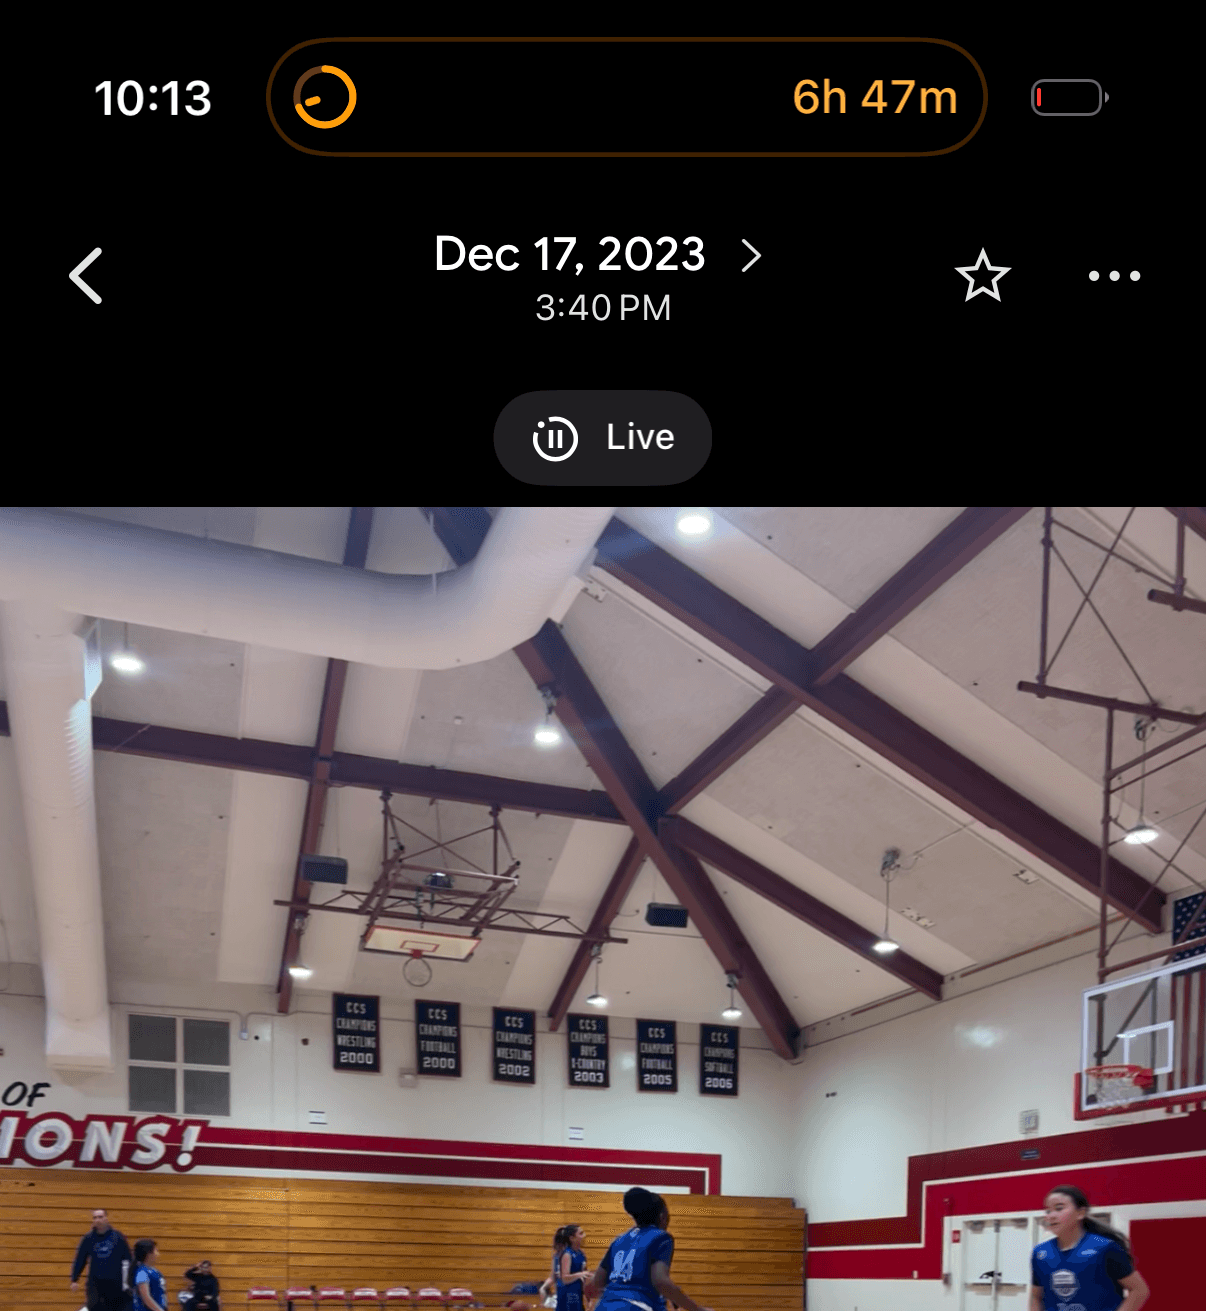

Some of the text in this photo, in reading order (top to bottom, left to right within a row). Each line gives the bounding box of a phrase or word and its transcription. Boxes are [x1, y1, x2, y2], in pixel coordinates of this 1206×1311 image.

[346, 1002, 366, 1014] CCS
[428, 1008, 448, 1020] CCS
[336, 1018, 376, 1031] CHAMPIONS
[505, 1016, 524, 1028] CCS
[579, 1019, 597, 1031] CCS
[419, 1024, 457, 1037] CHAMPIONS
[648, 1027, 666, 1038] CCS
[337, 1035, 376, 1048] WRESTLING
[496, 1031, 533, 1045] CHAMPIONS
[570, 1032, 606, 1044] CHAMPIONS
[710, 1032, 729, 1043] CCS
[420, 1040, 456, 1054] FOOTBALL
[640, 1042, 674, 1054] CHAMPIONS
[704, 1047, 735, 1058] CHAMPIONS
[340, 1052, 373, 1064] 2000
[497, 1047, 532, 1061] WRESTLING
[423, 1056, 455, 1069] 2000
[641, 1058, 673, 1070] FOOTBALL
[498, 1063, 530, 1076] 2002
[574, 1071, 604, 1083] 2003
[643, 1073, 672, 1085] 2005
[705, 1077, 733, 1089] 2006
[1, 1081, 51, 1107] OF
